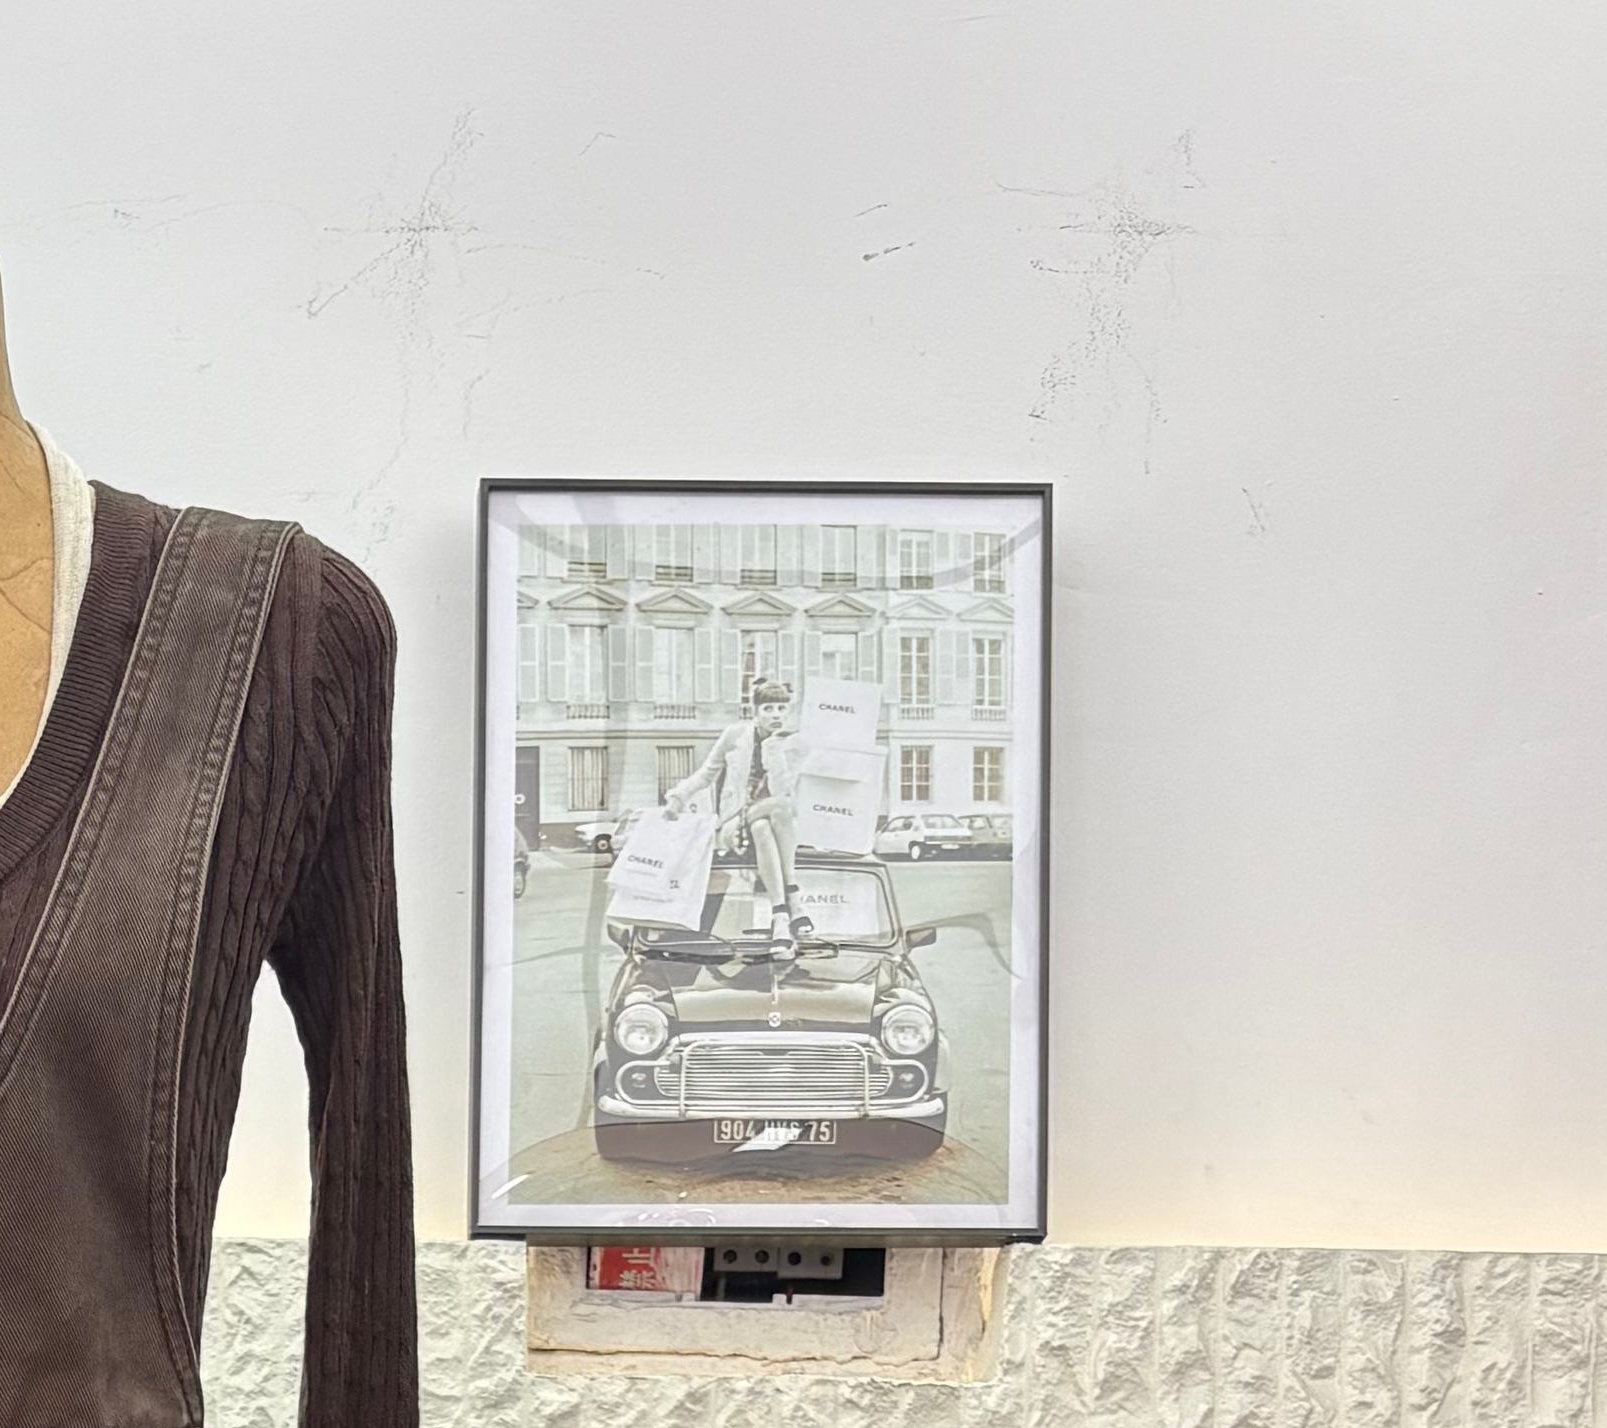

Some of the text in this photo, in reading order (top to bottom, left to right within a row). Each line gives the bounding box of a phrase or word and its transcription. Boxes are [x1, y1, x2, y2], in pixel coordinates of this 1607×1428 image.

[818, 703, 856, 714] CHANEL
[812, 804, 854, 817] CHANEL
[805, 1121, 831, 1141] 75
